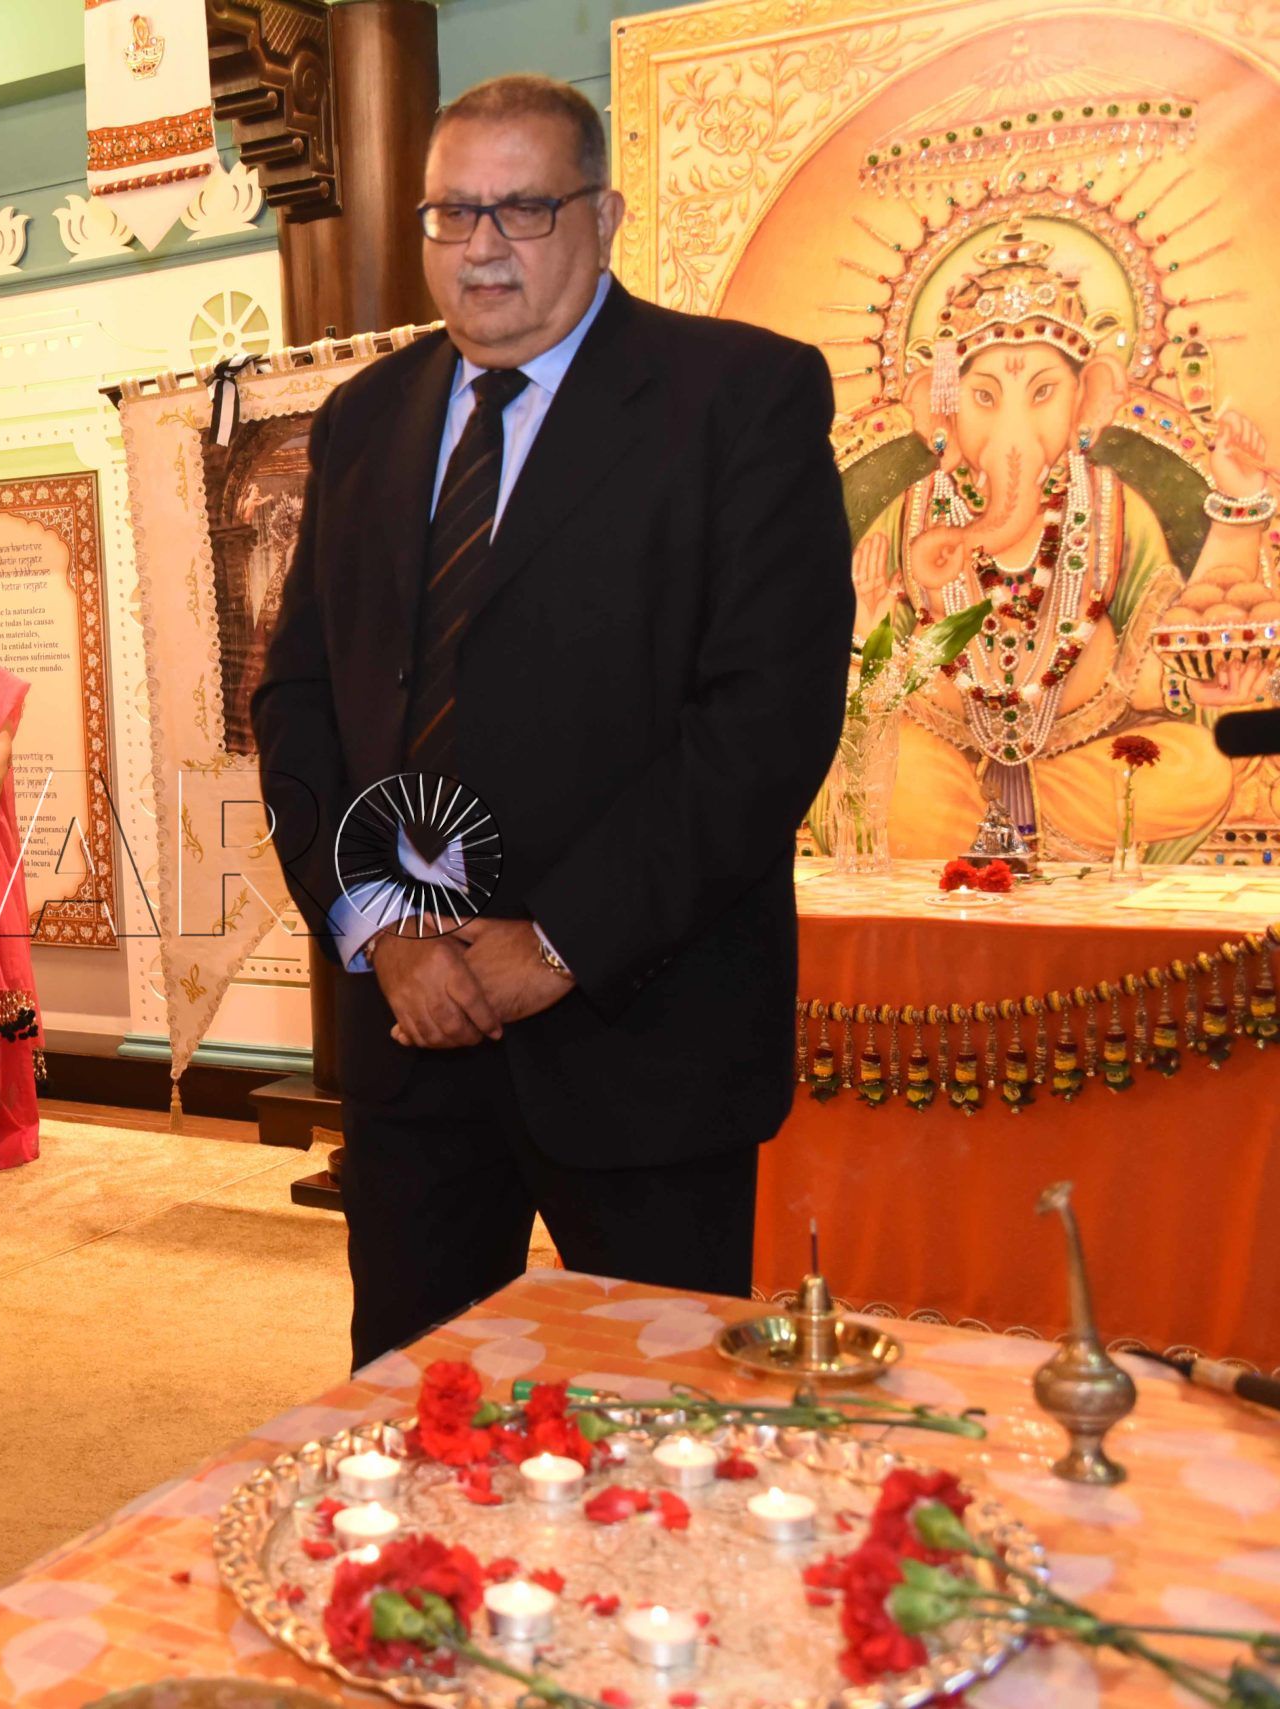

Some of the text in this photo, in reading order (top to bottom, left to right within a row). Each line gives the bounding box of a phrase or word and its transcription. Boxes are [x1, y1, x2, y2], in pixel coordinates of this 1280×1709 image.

[5, 607, 11, 616] la
[12, 606, 46, 616] naturaleza
[5, 619, 22, 627] todas
[23, 618, 32, 626] las
[33, 618, 54, 626] causas
[5, 630, 40, 639] materiales,
[1, 642, 7, 651] la
[8, 641, 32, 650] entidad
[33, 641, 59, 650] viviente
[3, 653, 29, 662] diversos
[30, 652, 71, 661] sufrimientos
[25, 665, 39, 673] este
[39, 663, 64, 672] mundo.
[18, 825, 27, 833] de
[34, 825, 68, 835] ignorancia
[30, 848, 62, 856] oscuridad
[30, 859, 51, 867] locura
